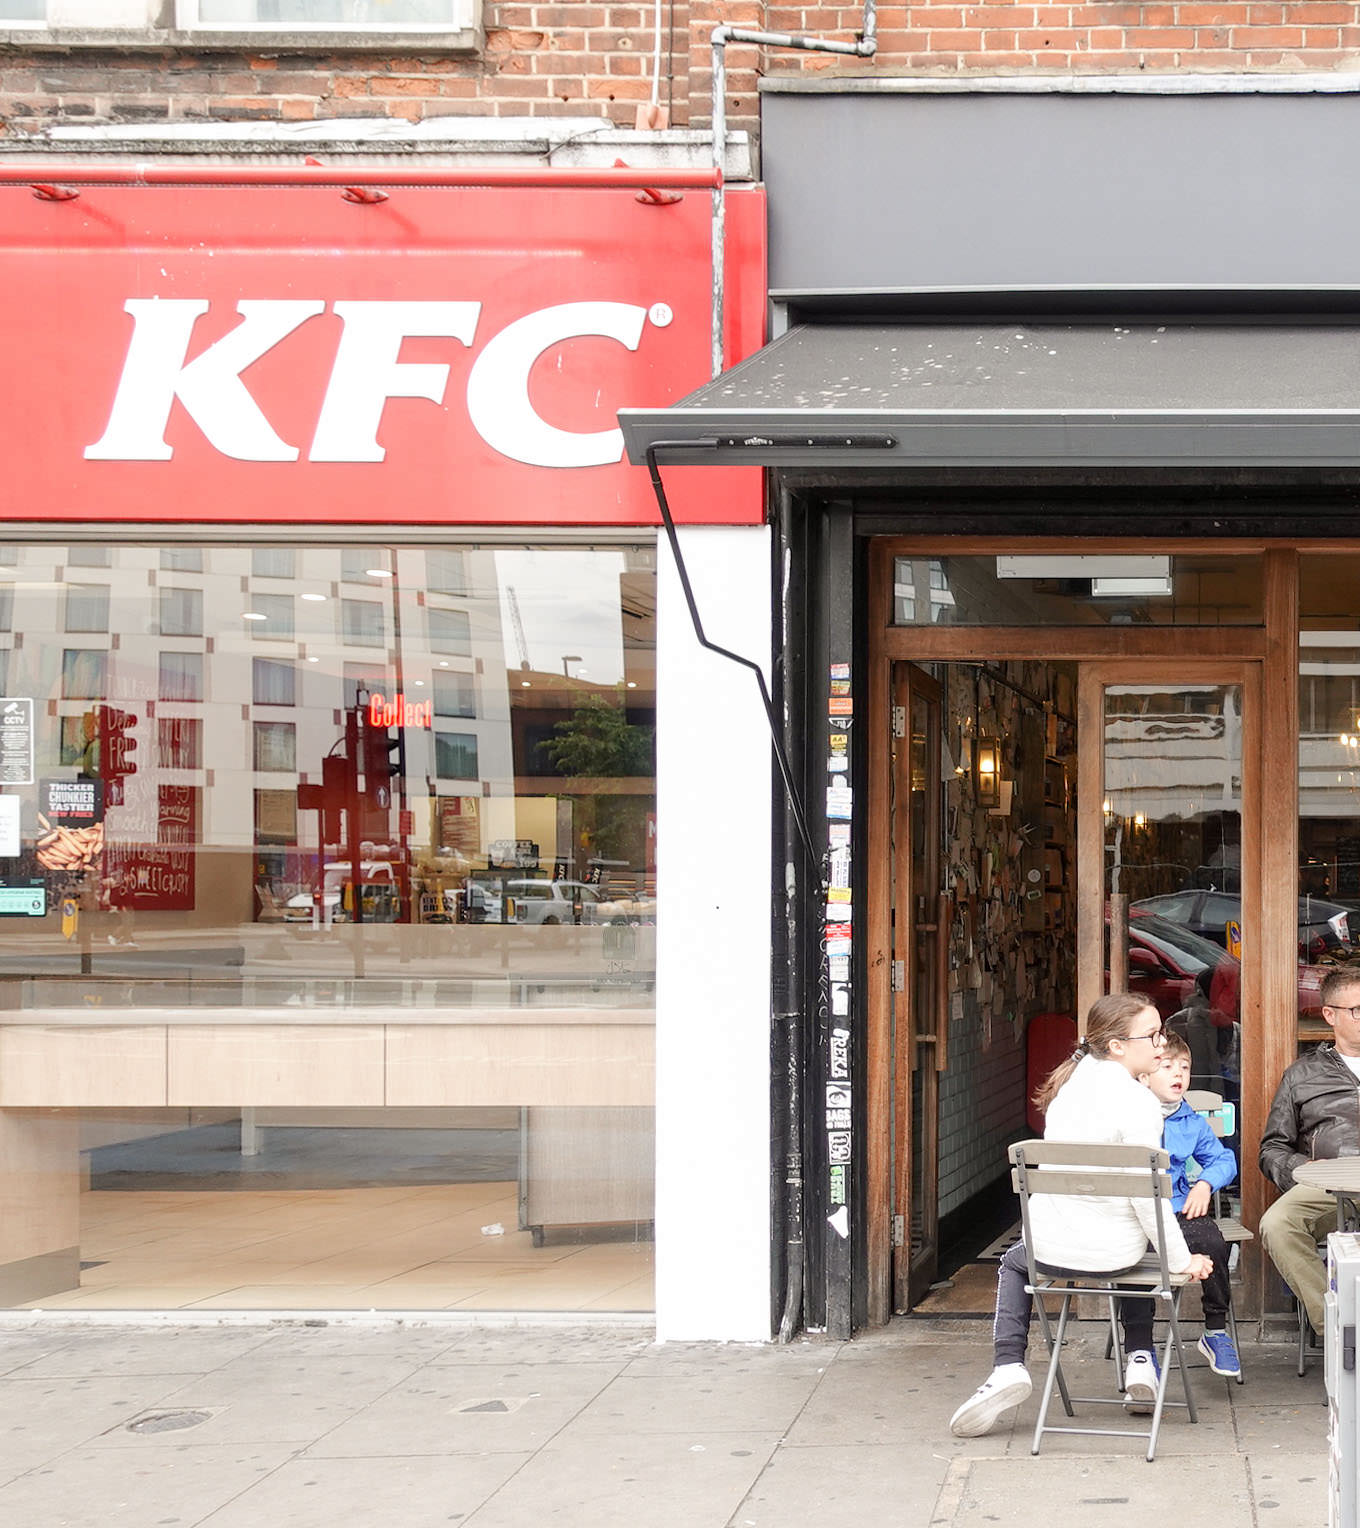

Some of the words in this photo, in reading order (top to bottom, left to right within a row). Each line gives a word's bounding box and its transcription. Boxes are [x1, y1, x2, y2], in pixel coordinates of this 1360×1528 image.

[84, 299, 647, 468] KFC
[370, 693, 432, 728] Collect
[49, 791, 95, 803] CHUNKIER
[49, 803, 95, 812] TASTIER
